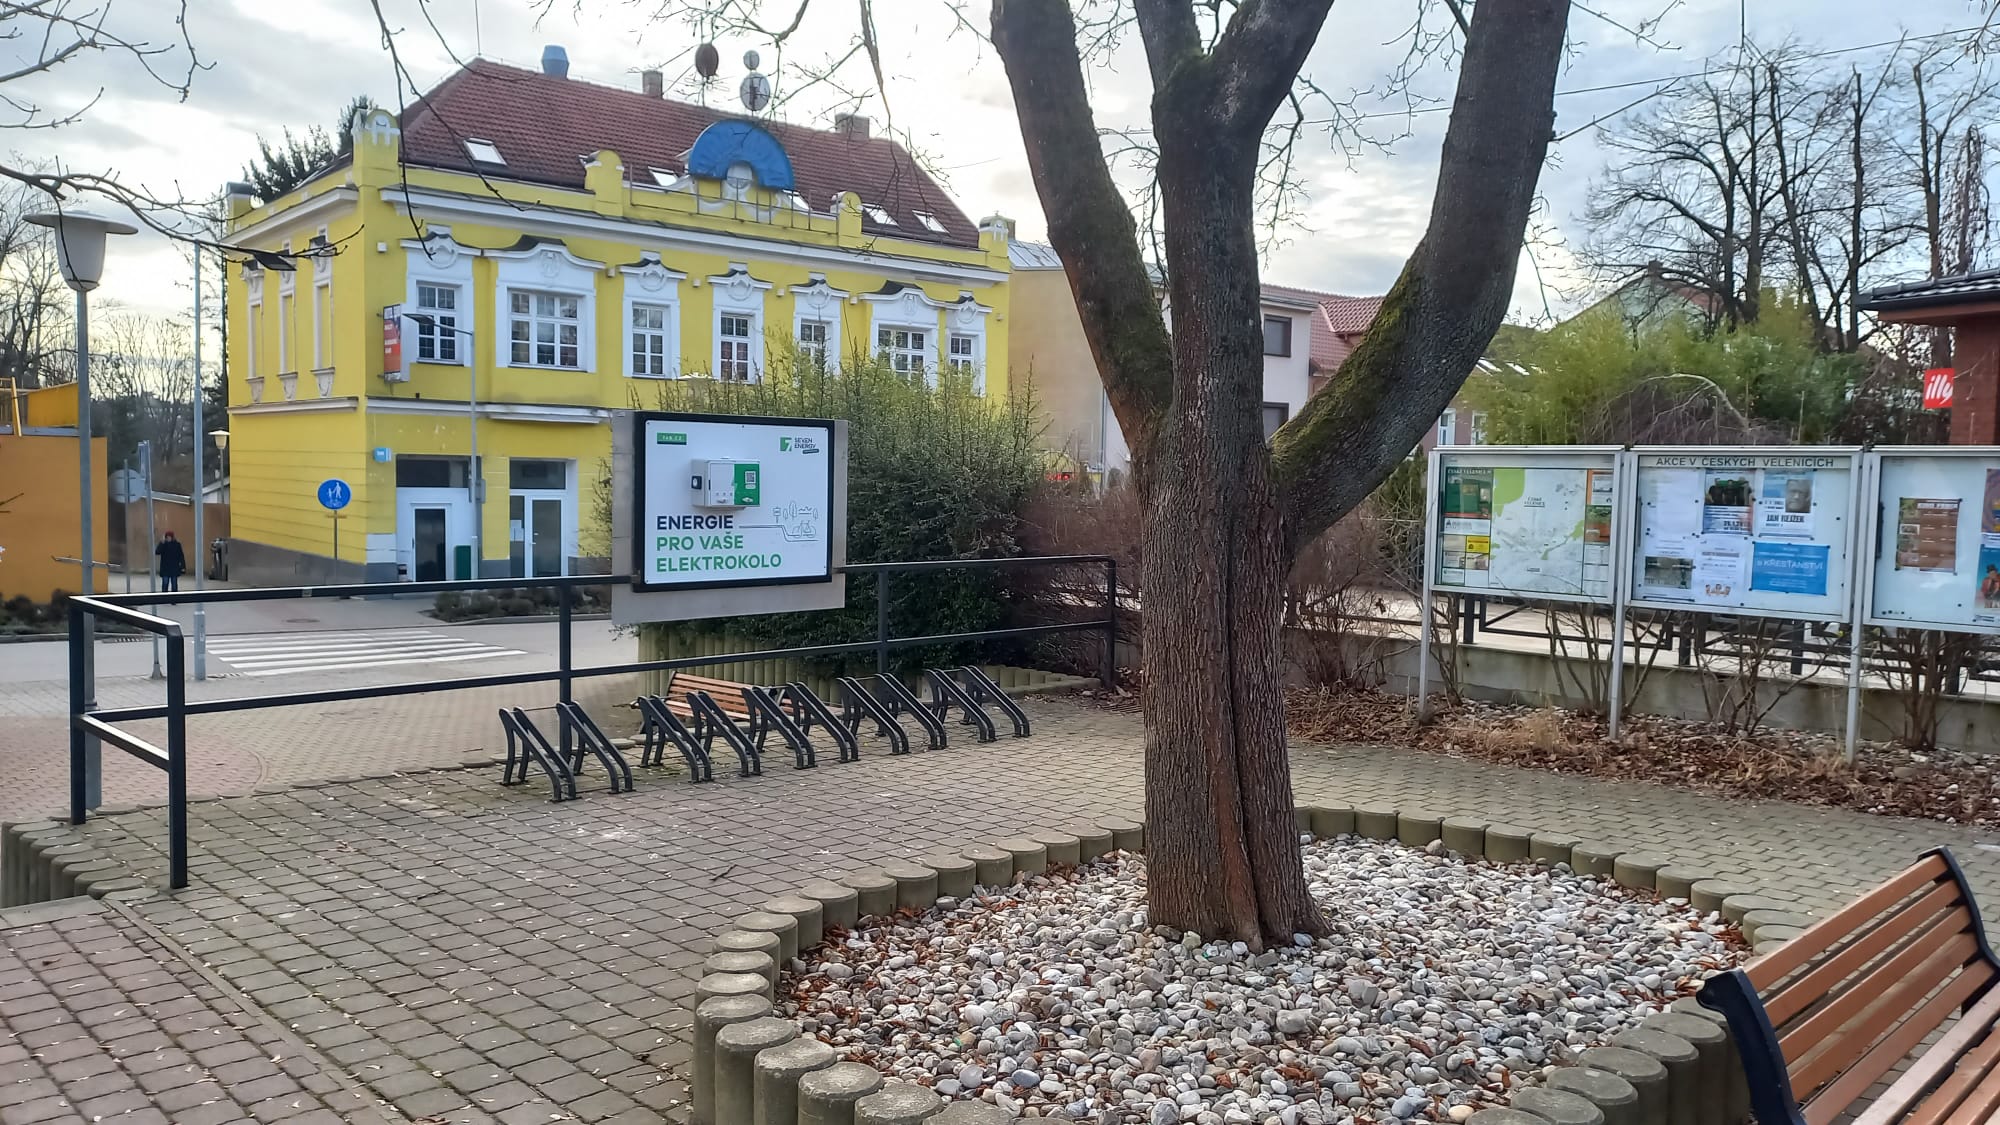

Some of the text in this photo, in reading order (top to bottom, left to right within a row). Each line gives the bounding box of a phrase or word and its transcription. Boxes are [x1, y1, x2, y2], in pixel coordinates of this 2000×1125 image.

[1925, 374, 1953, 405] illy
[1656, 457, 1686, 466] AKCE
[1689, 457, 1697, 466] V
[656, 515, 734, 530] ENERGIE
[656, 531, 744, 551] PRO VAŠE
[656, 554, 782, 572] ELEKTROKOLO
